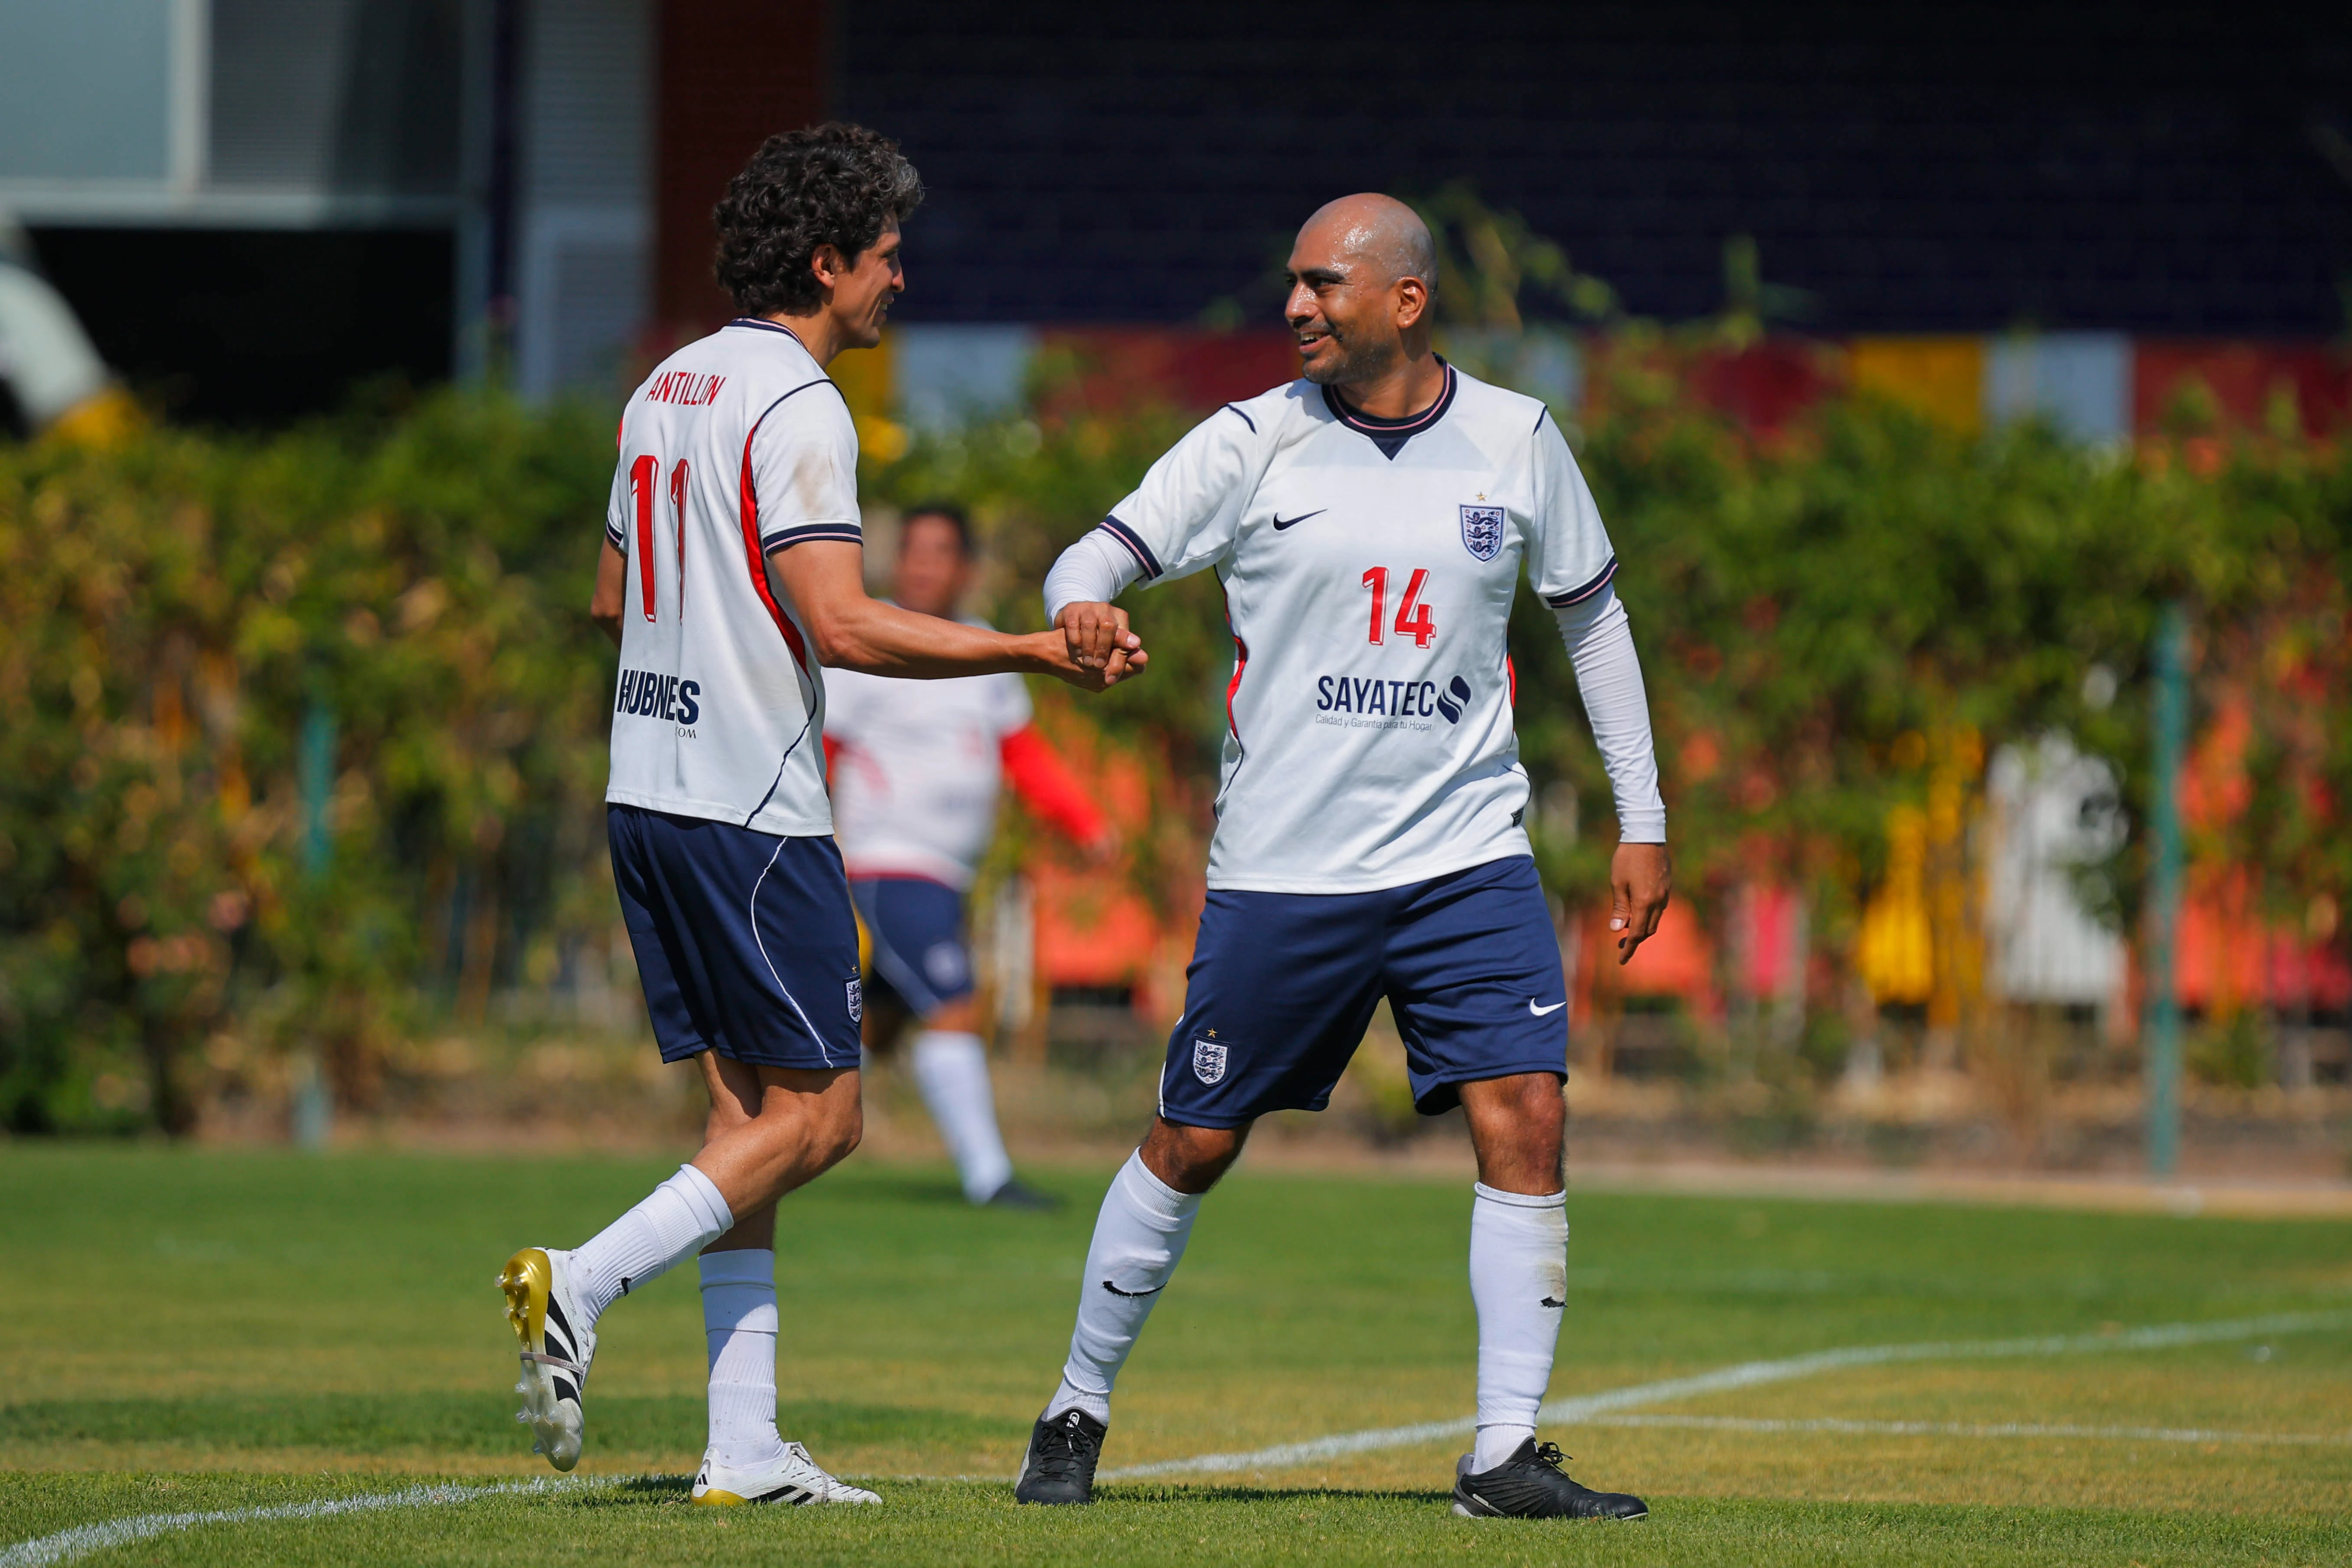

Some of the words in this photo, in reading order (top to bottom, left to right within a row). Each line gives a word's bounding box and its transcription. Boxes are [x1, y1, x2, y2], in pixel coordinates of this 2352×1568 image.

[644, 371, 727, 406] ANTILLON
[630, 455, 690, 627] 11
[1362, 566, 1436, 649] 14
[1317, 675, 1436, 717] SAYATEC
[1315, 714, 1343, 726] Calidad
[1344, 719, 1349, 729] y
[1383, 721, 1399, 731] para
[1400, 719, 1408, 729] tu
[1409, 719, 1432, 732] Hogar
